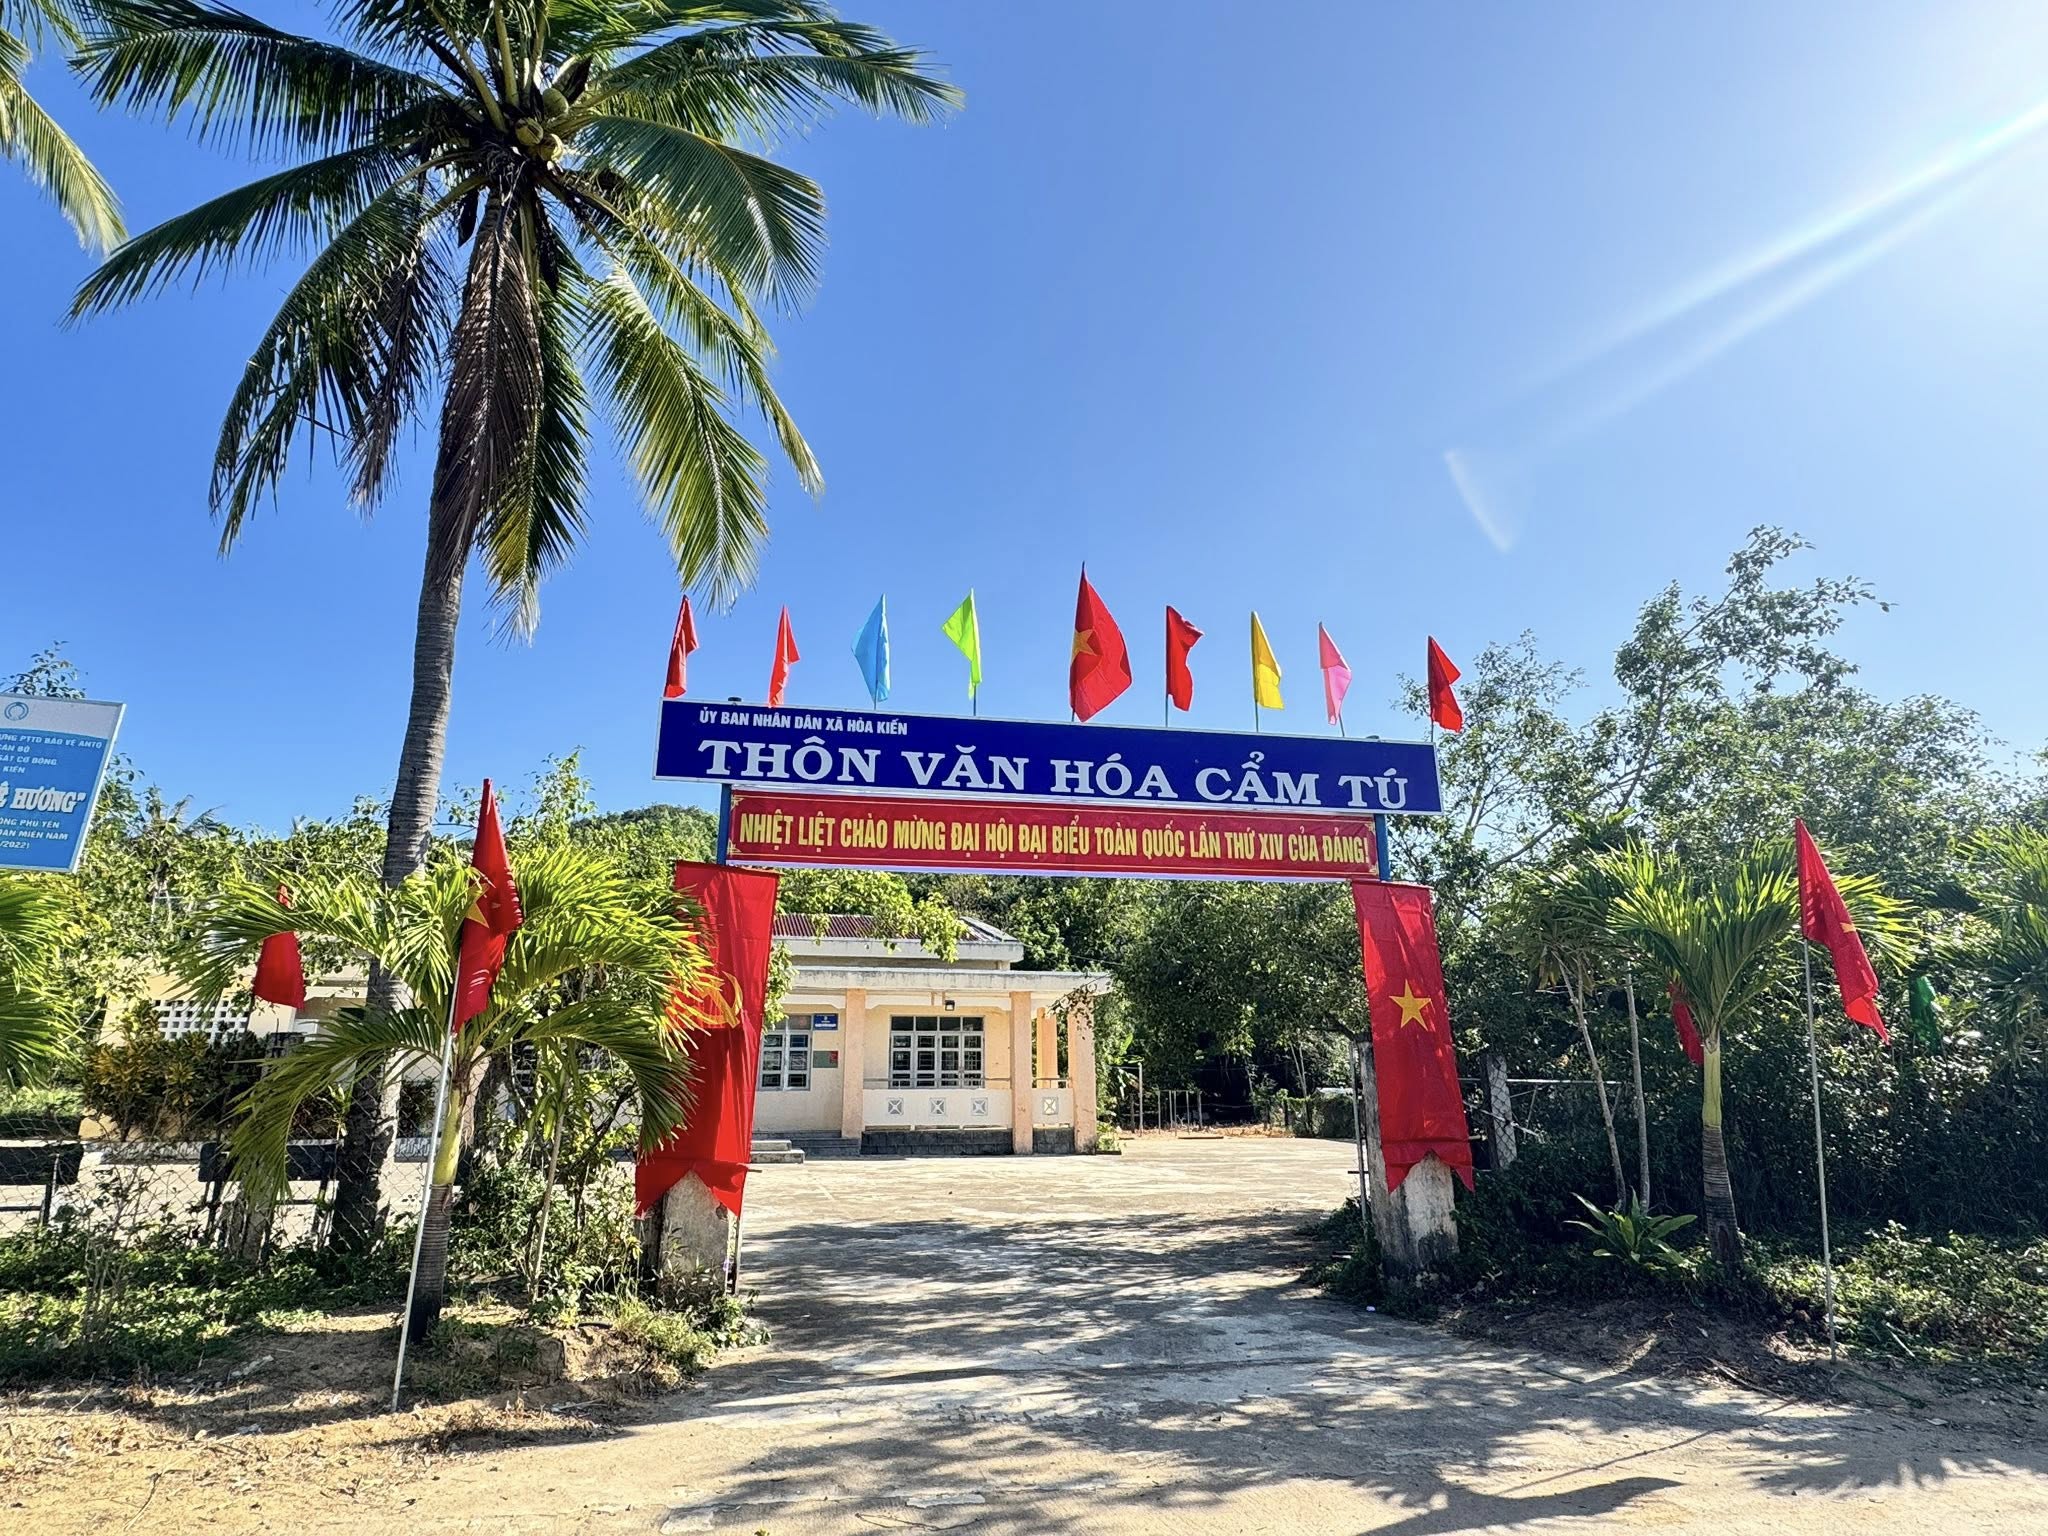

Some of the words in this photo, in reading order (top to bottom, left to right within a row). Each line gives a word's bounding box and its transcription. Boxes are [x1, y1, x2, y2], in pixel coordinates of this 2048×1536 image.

[699, 706, 718, 724] ỦY
[721, 711, 750, 726] BAN
[753, 712, 791, 729] NHÂN
[794, 715, 822, 731] DÂN
[825, 716, 844, 732] XÃ
[847, 717, 874, 734] HÒA
[877, 718, 908, 736] KIẾN
[697, 735, 882, 783] THÔN
[901, 744, 1029, 790] VĂN
[1049, 752, 1179, 799] HÓA
[1195, 750, 1322, 805] CẨM
[1338, 768, 1409, 810] TÚ
[46, 832, 69, 841] NAM
[739, 808, 794, 851] NHIỆT
[798, 810, 836, 853] LIỆT
[840, 813, 888, 848] CHÀO
[893, 814, 946, 851] MỪNG
[950, 822, 980, 858] ĐẠI
[985, 817, 1014, 859] HỘI
[1018, 824, 1047, 860] ĐẠI
[1052, 814, 1090, 855] BIỂU
[1094, 821, 1138, 857] TOÀN
[1141, 819, 1185, 860] QUỐC
[1189, 821, 1221, 859] LẦN
[1224, 826, 1256, 860] THỨ
[1258, 832, 1284, 861] XIV
[1288, 825, 1320, 862] CỦA
[1322, 826, 1370, 864] ĐẢNG!
